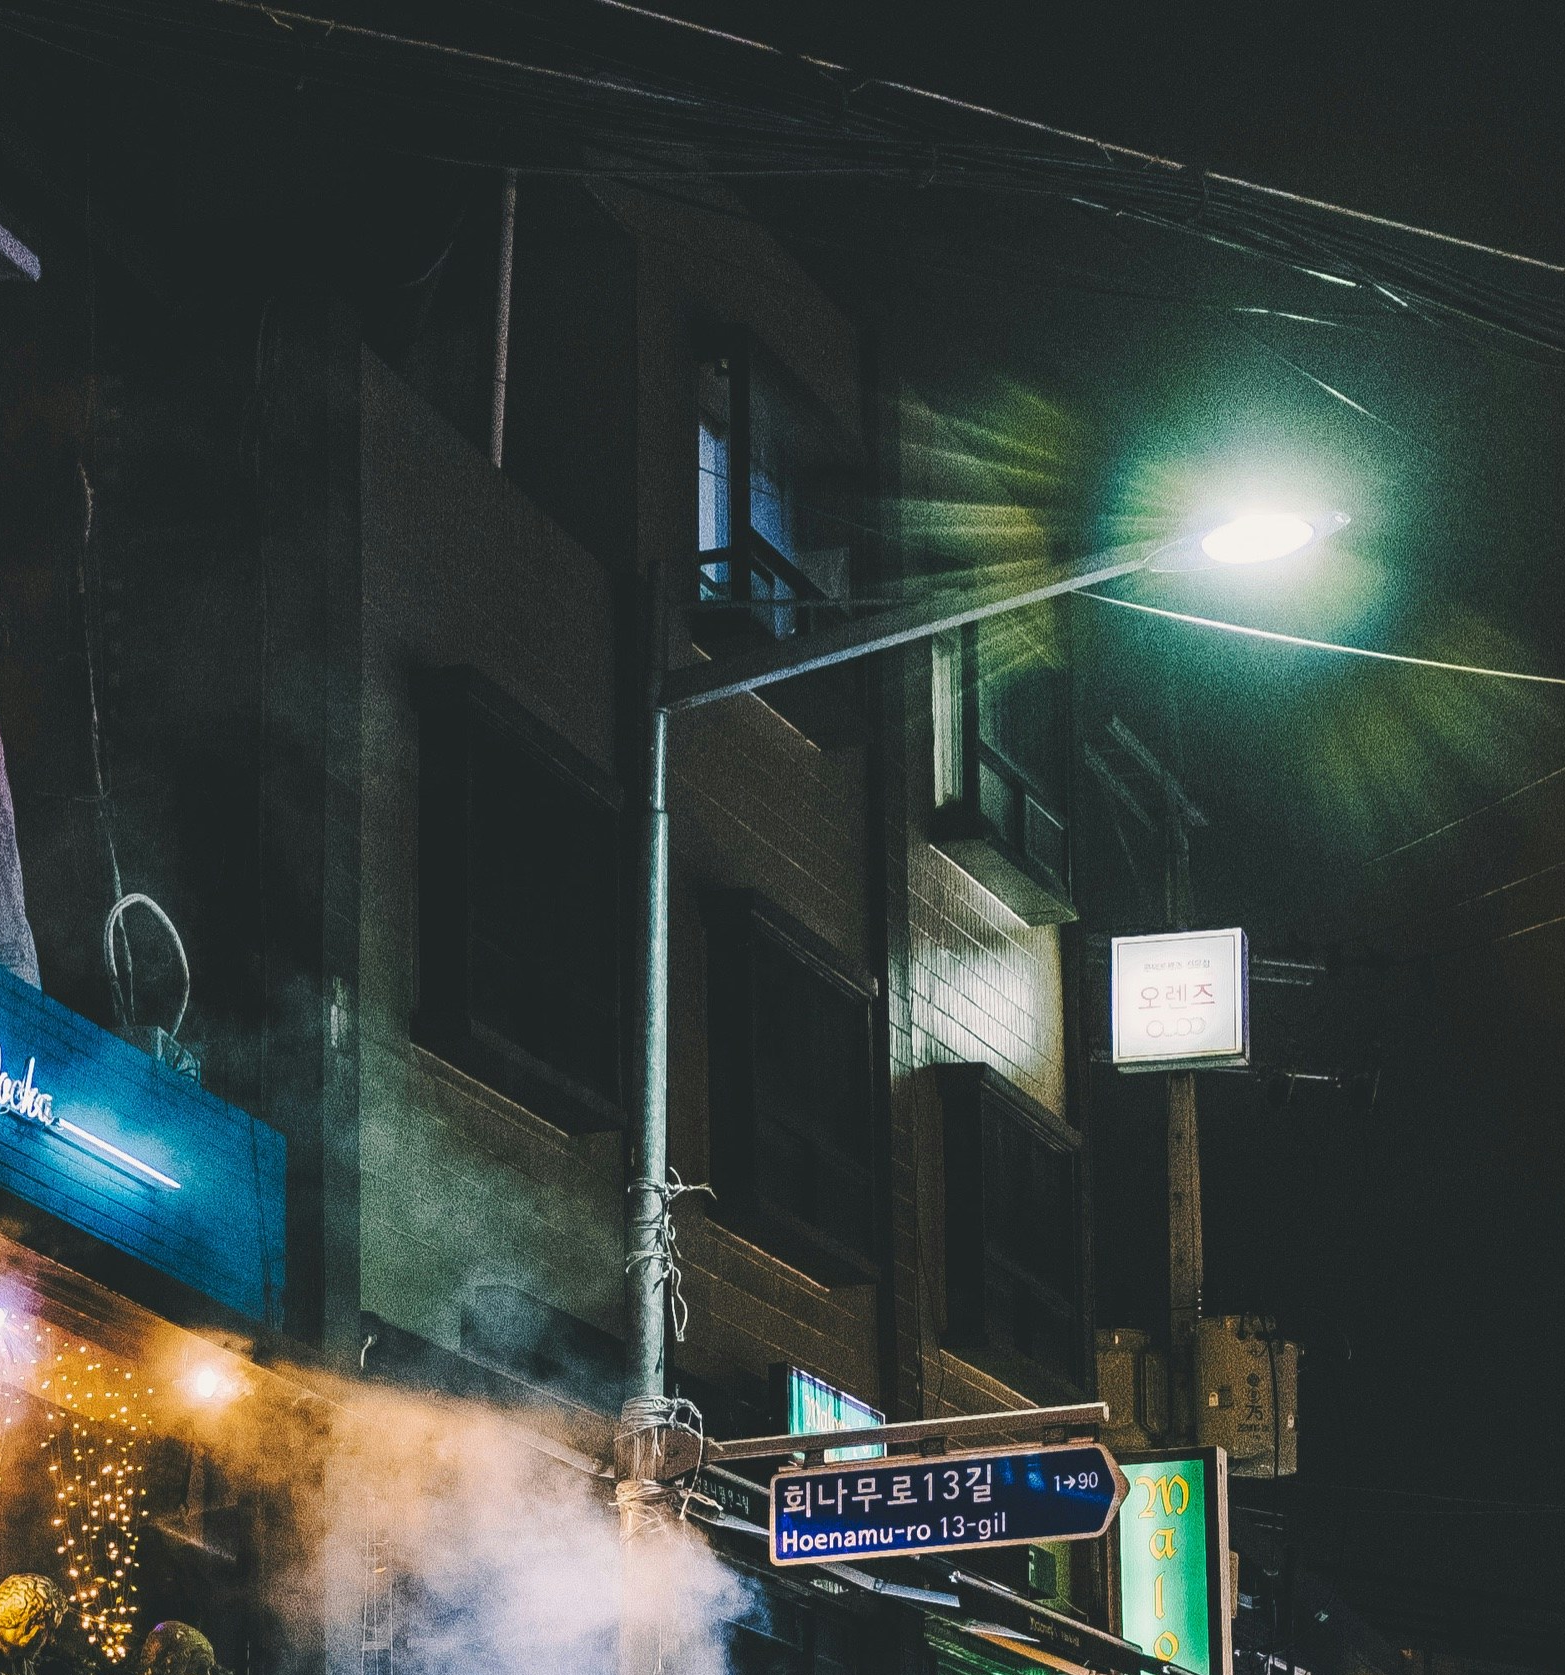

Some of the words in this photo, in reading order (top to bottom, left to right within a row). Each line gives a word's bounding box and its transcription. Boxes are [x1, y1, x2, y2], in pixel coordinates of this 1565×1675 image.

[1137, 982, 1216, 1011] 오렌즈
[782, 1463, 994, 1519] 회나무로13길
[781, 1520, 933, 1555] Hoenamu-ro
[939, 1511, 1007, 1540] 13-gil
